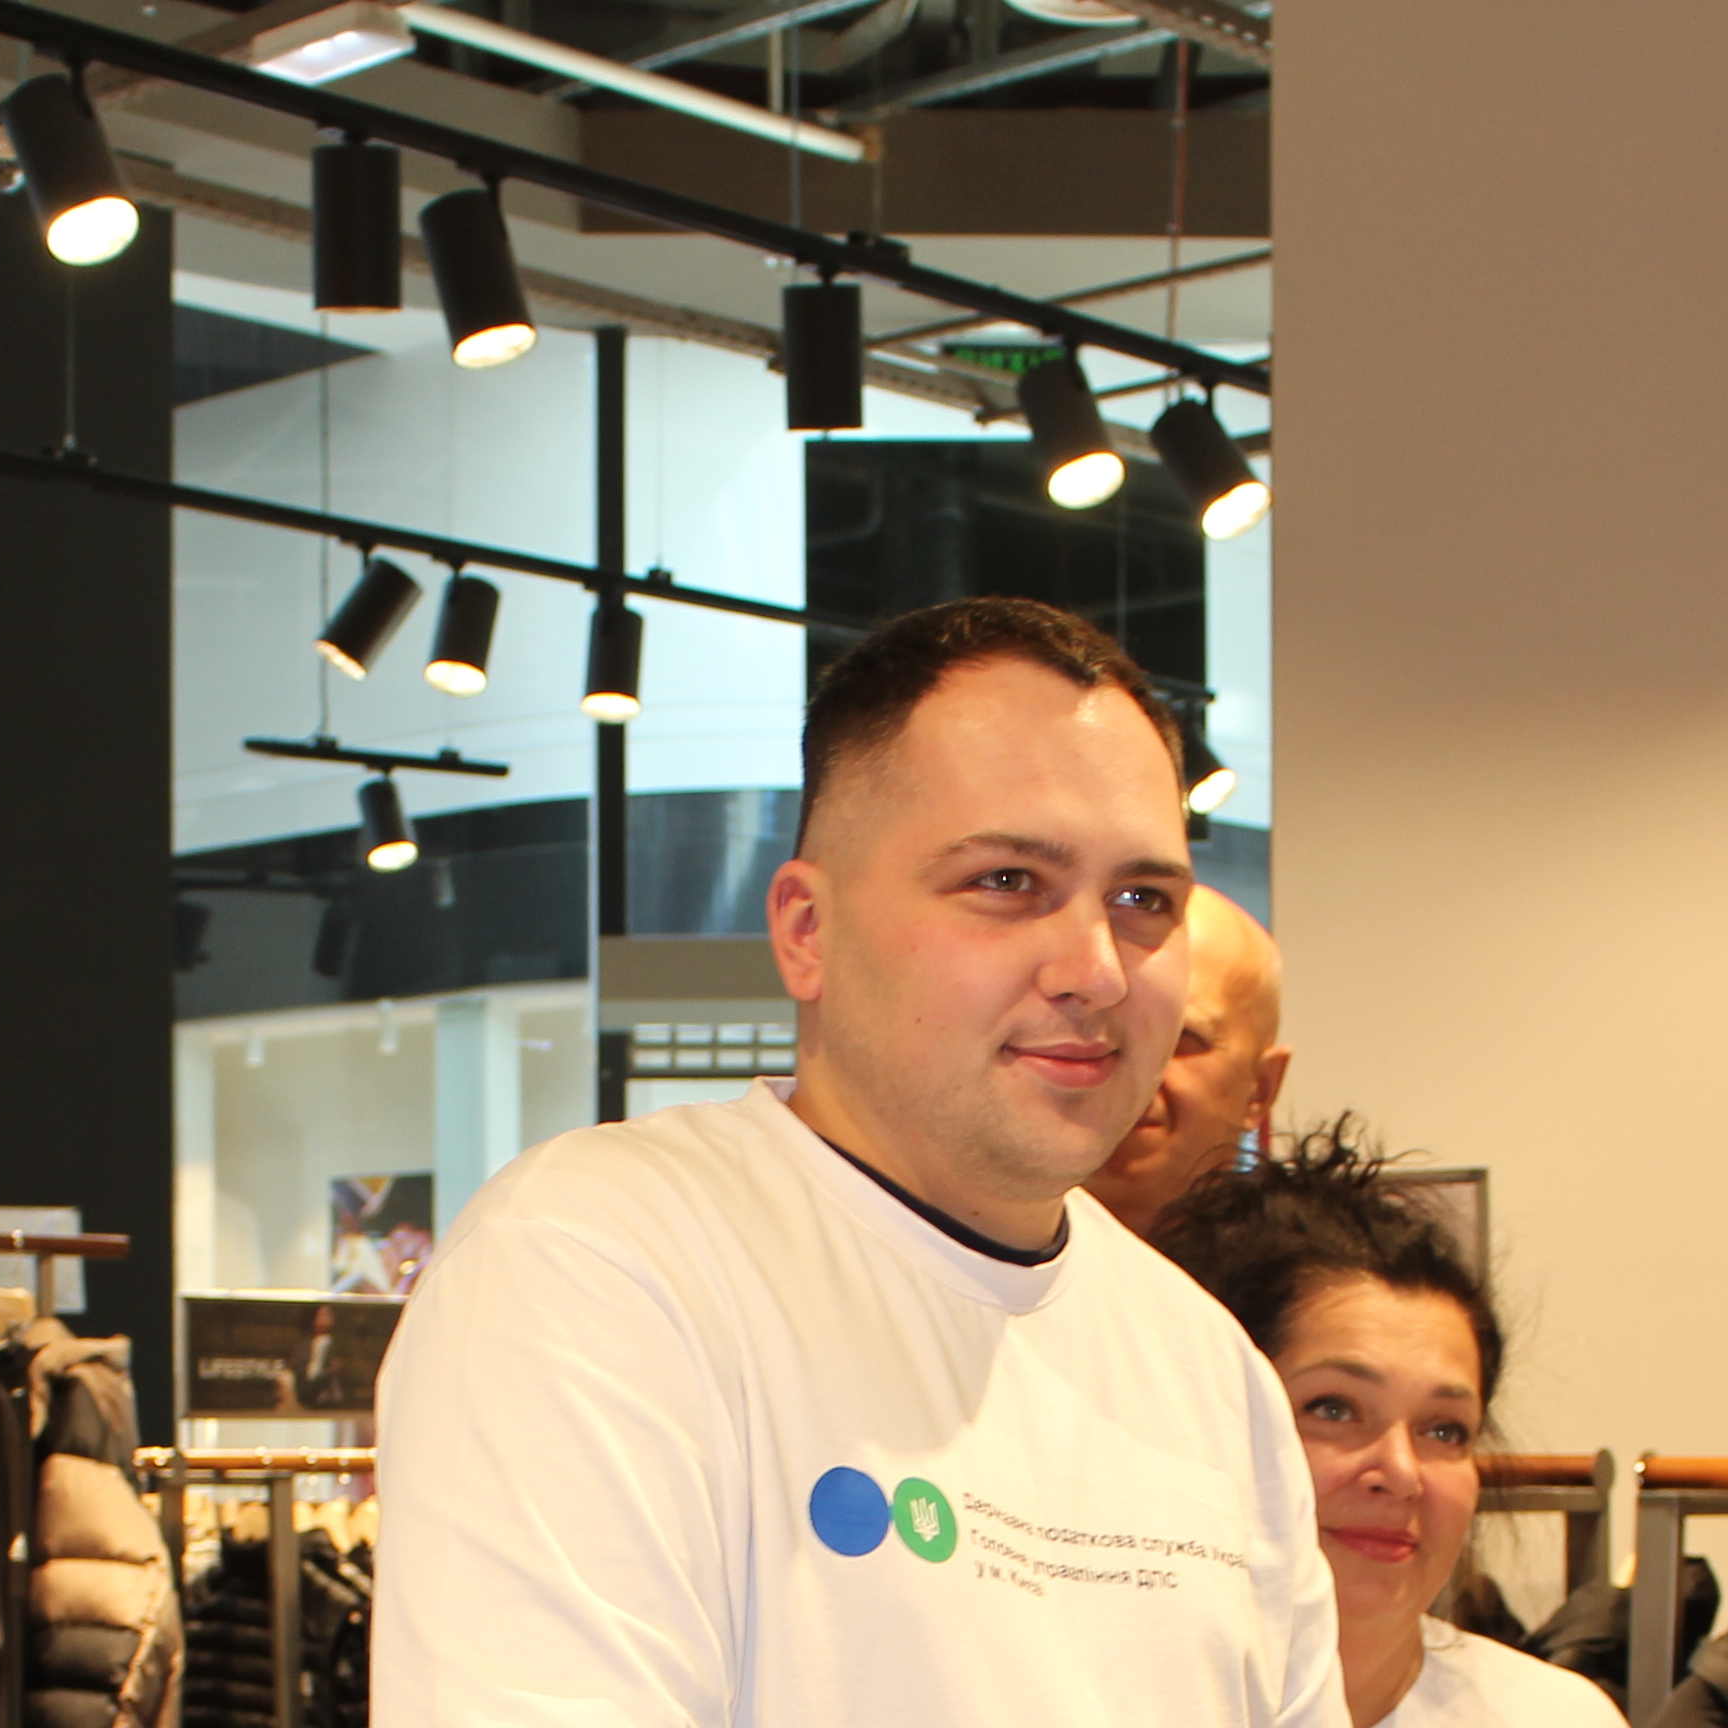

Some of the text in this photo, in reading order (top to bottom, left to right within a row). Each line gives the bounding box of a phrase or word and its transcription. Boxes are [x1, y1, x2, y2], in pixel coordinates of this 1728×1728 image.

[1035, 1526, 1136, 1550] податкова
[1140, 1536, 1208, 1559] служба
[1136, 1568, 1179, 1590] ДПС
